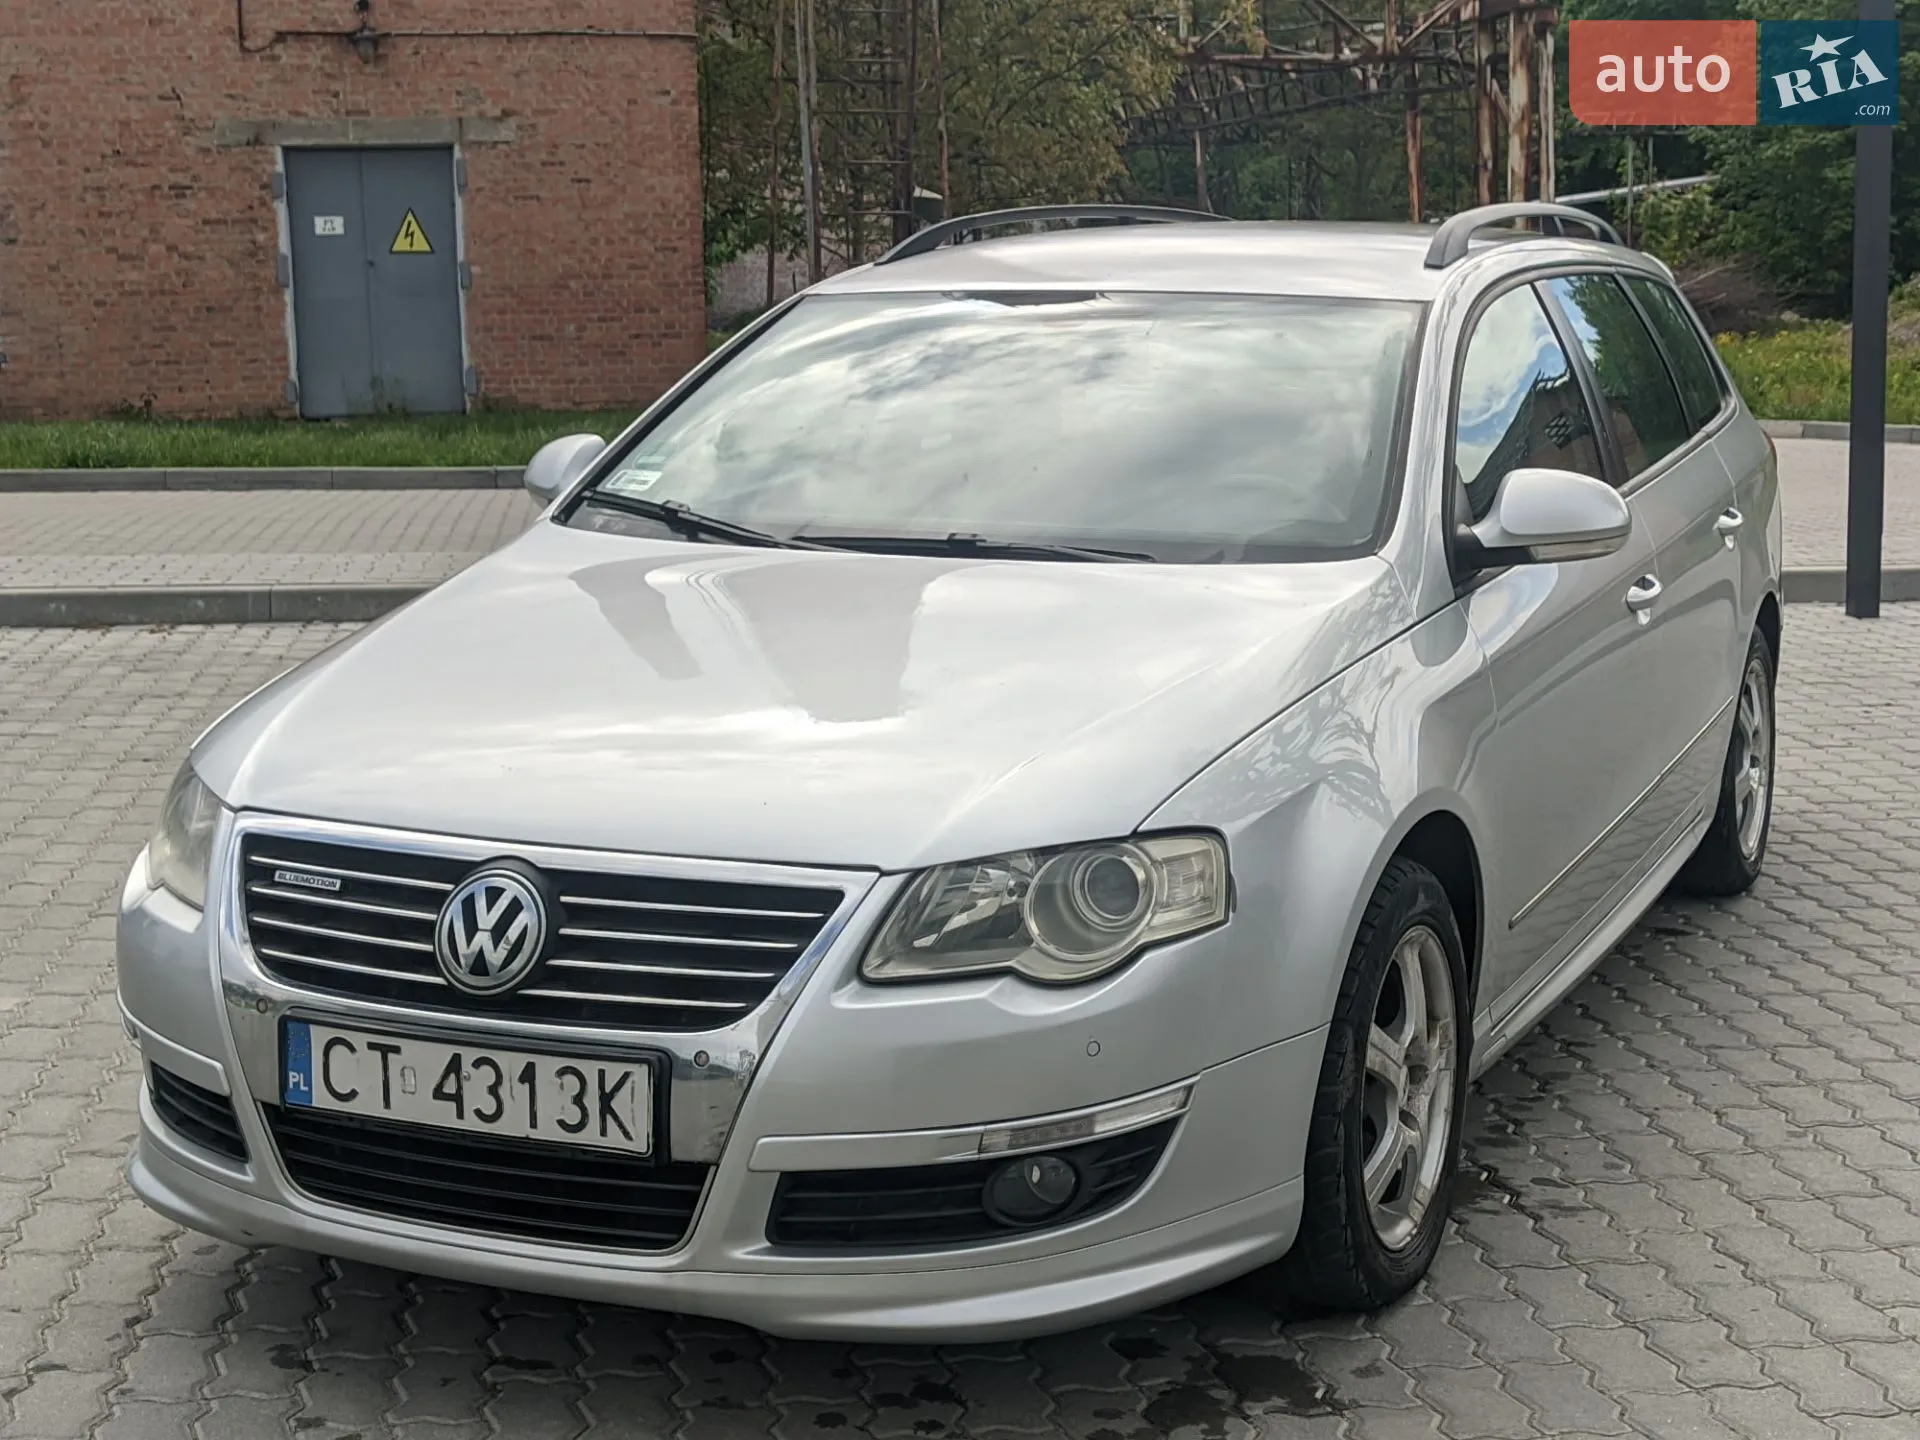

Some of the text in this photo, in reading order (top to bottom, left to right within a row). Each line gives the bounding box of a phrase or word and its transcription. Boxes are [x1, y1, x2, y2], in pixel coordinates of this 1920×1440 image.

[276, 871, 338, 889] BLUEMOTION
[288, 1071, 309, 1091] PL
[322, 1036, 635, 1142] CT 4313K
